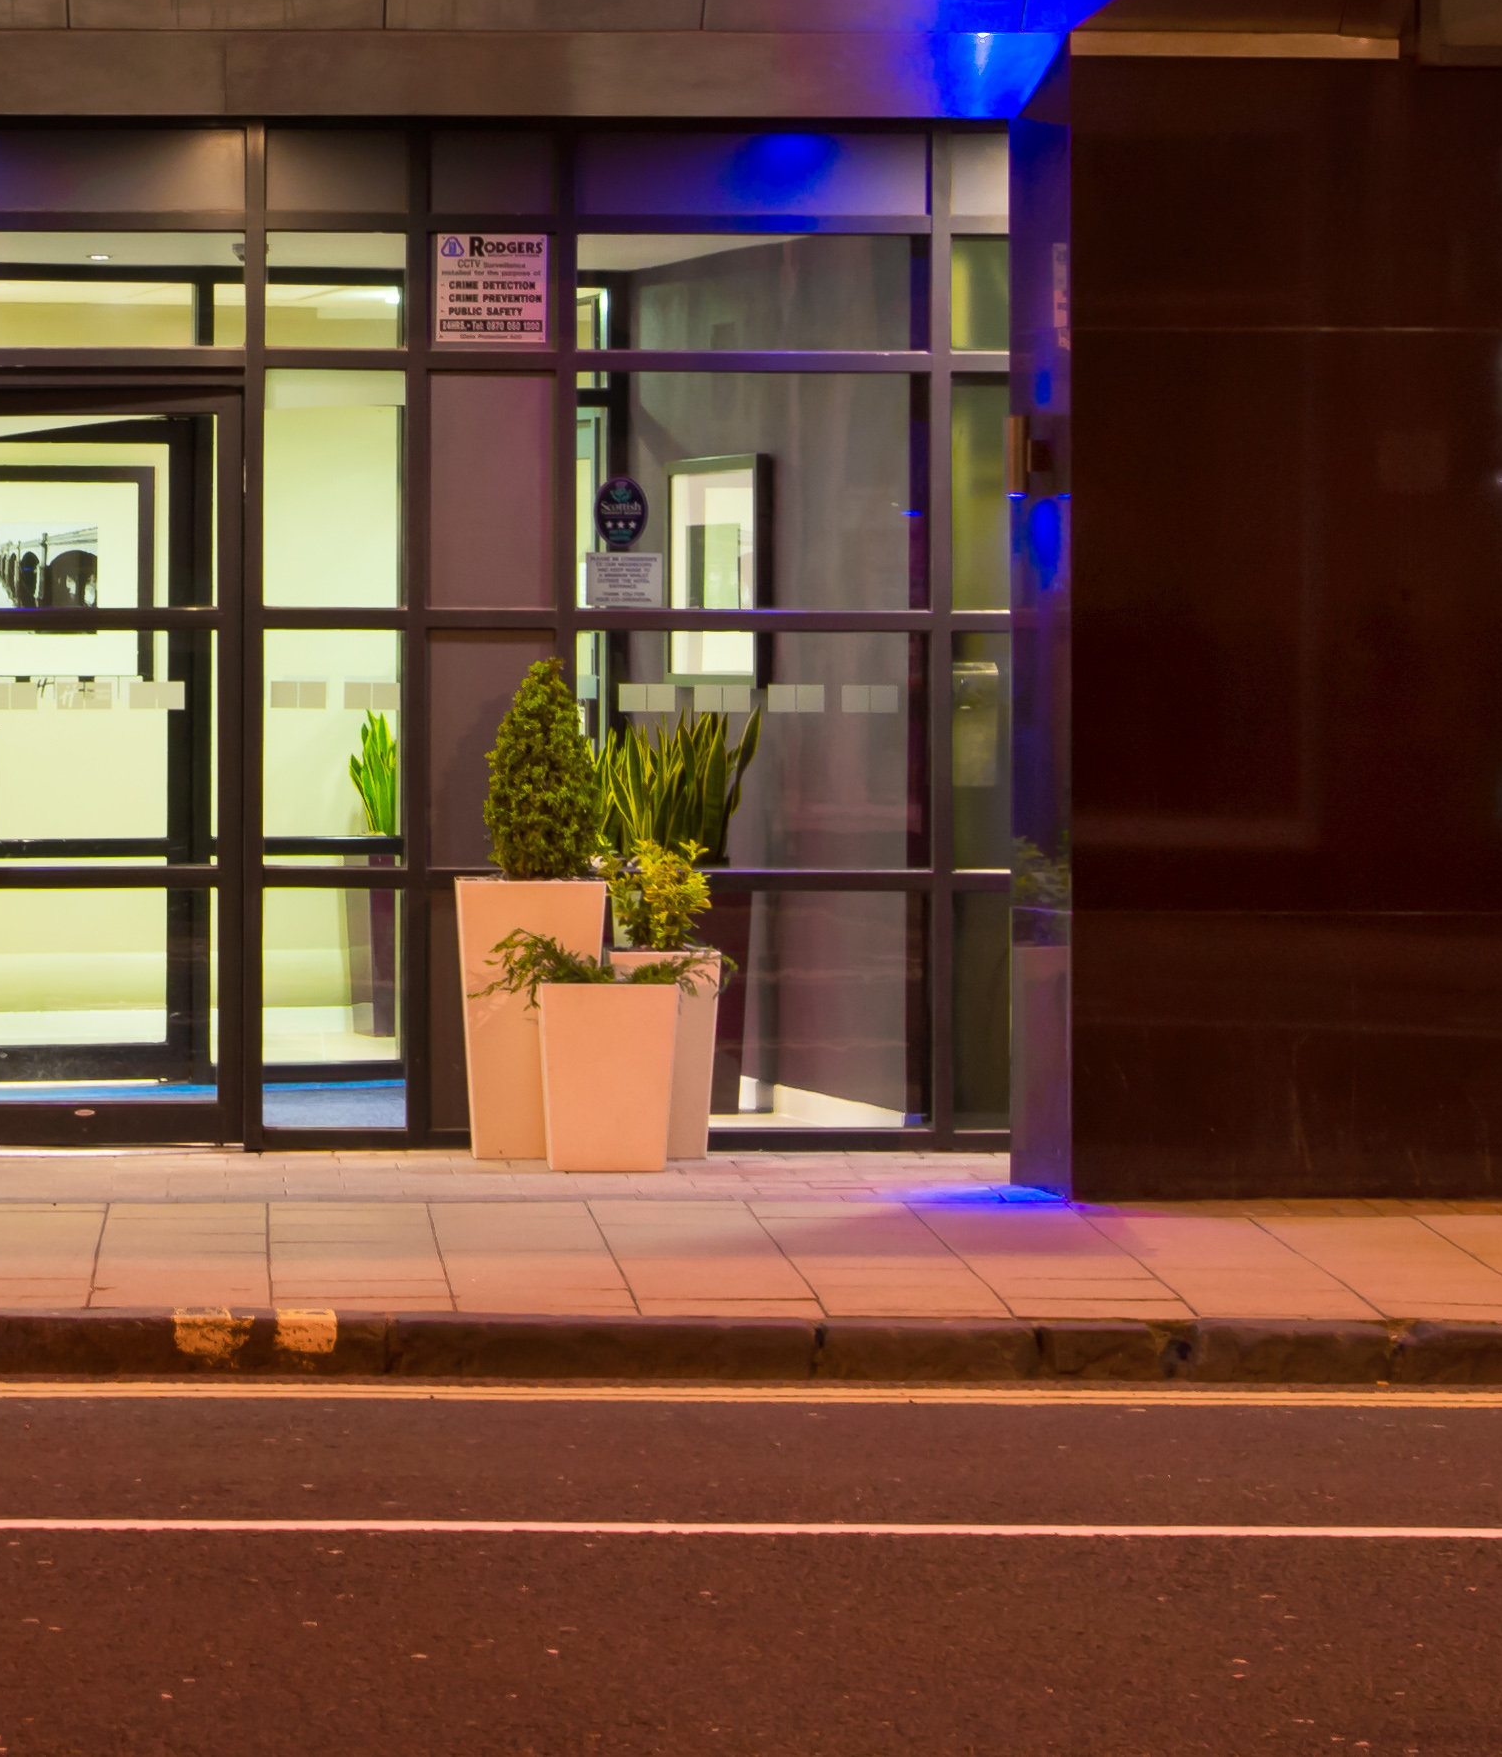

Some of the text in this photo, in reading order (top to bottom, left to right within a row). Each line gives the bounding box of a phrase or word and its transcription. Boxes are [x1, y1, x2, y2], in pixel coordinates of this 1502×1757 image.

[469, 236, 543, 257] RODGERS
[457, 259, 481, 268] CCTV
[448, 281, 536, 290] CRIME DETECTION
[448, 294, 542, 303] CRIME PREVENTION
[448, 307, 523, 316] PUBLIC SAFETY
[600, 501, 642, 511] Scottish
